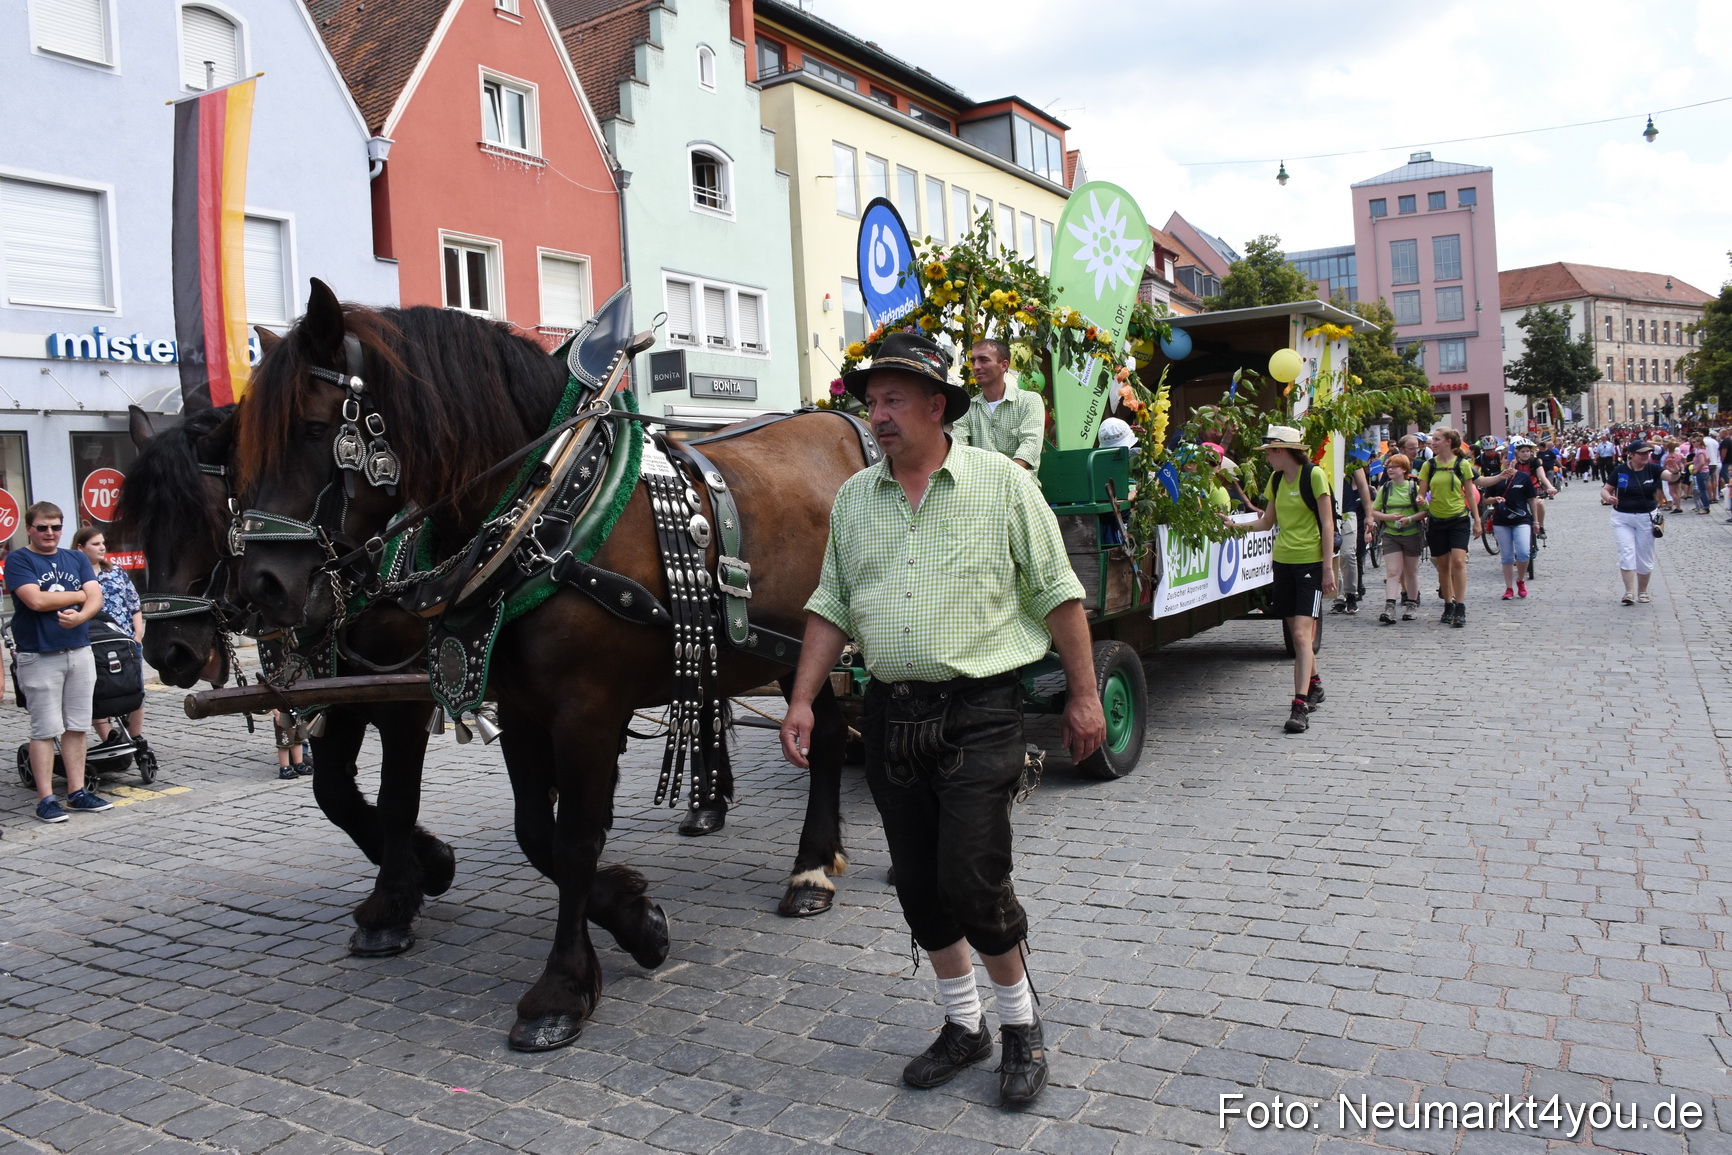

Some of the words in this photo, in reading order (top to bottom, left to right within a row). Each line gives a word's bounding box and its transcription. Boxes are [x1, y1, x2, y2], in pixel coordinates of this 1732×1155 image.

[50, 325, 179, 365] miste
[1426, 382, 1469, 392] arkasse
[1080, 400, 1099, 440] Sektion
[110, 556, 133, 566] SALE
[1241, 562, 1266, 581] Neumarkt
